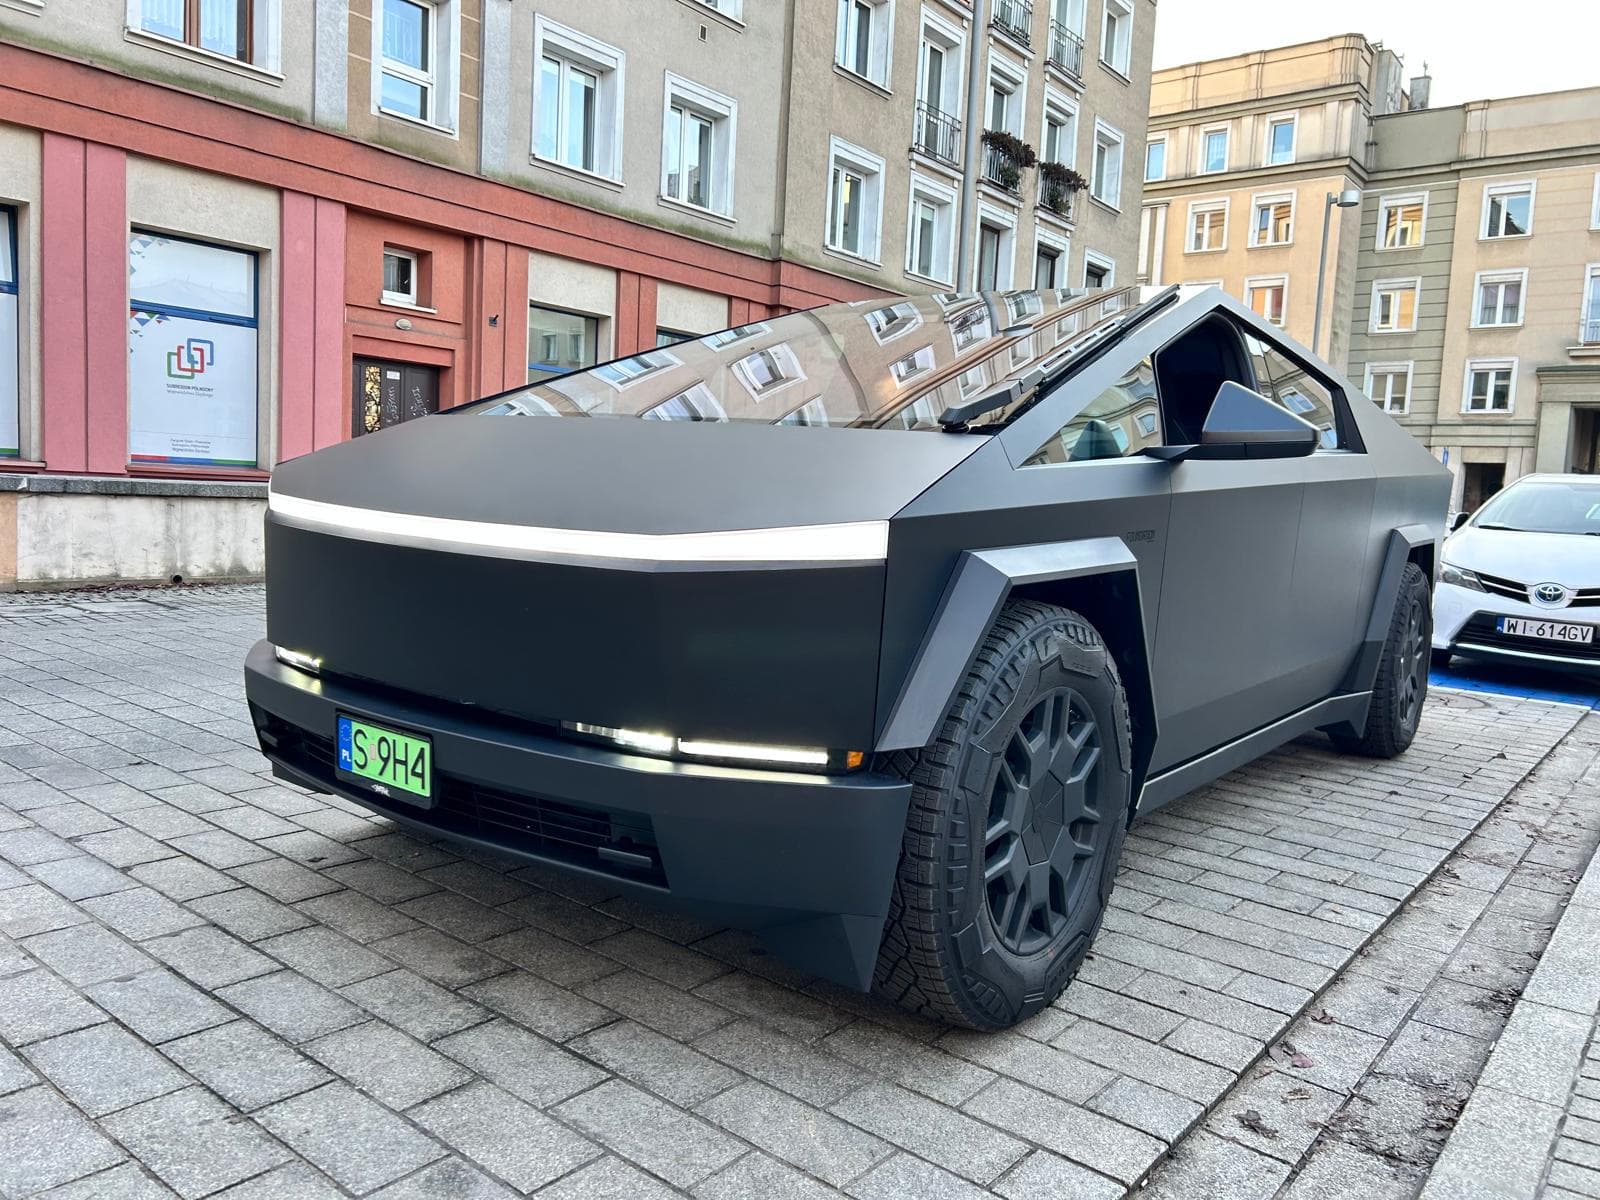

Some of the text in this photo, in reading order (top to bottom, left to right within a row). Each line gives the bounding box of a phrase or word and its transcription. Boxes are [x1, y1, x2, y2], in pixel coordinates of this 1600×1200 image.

[1506, 619, 1590, 641] WI 614GV
[342, 748, 351, 762] PL
[354, 729, 425, 790] S 9H4
